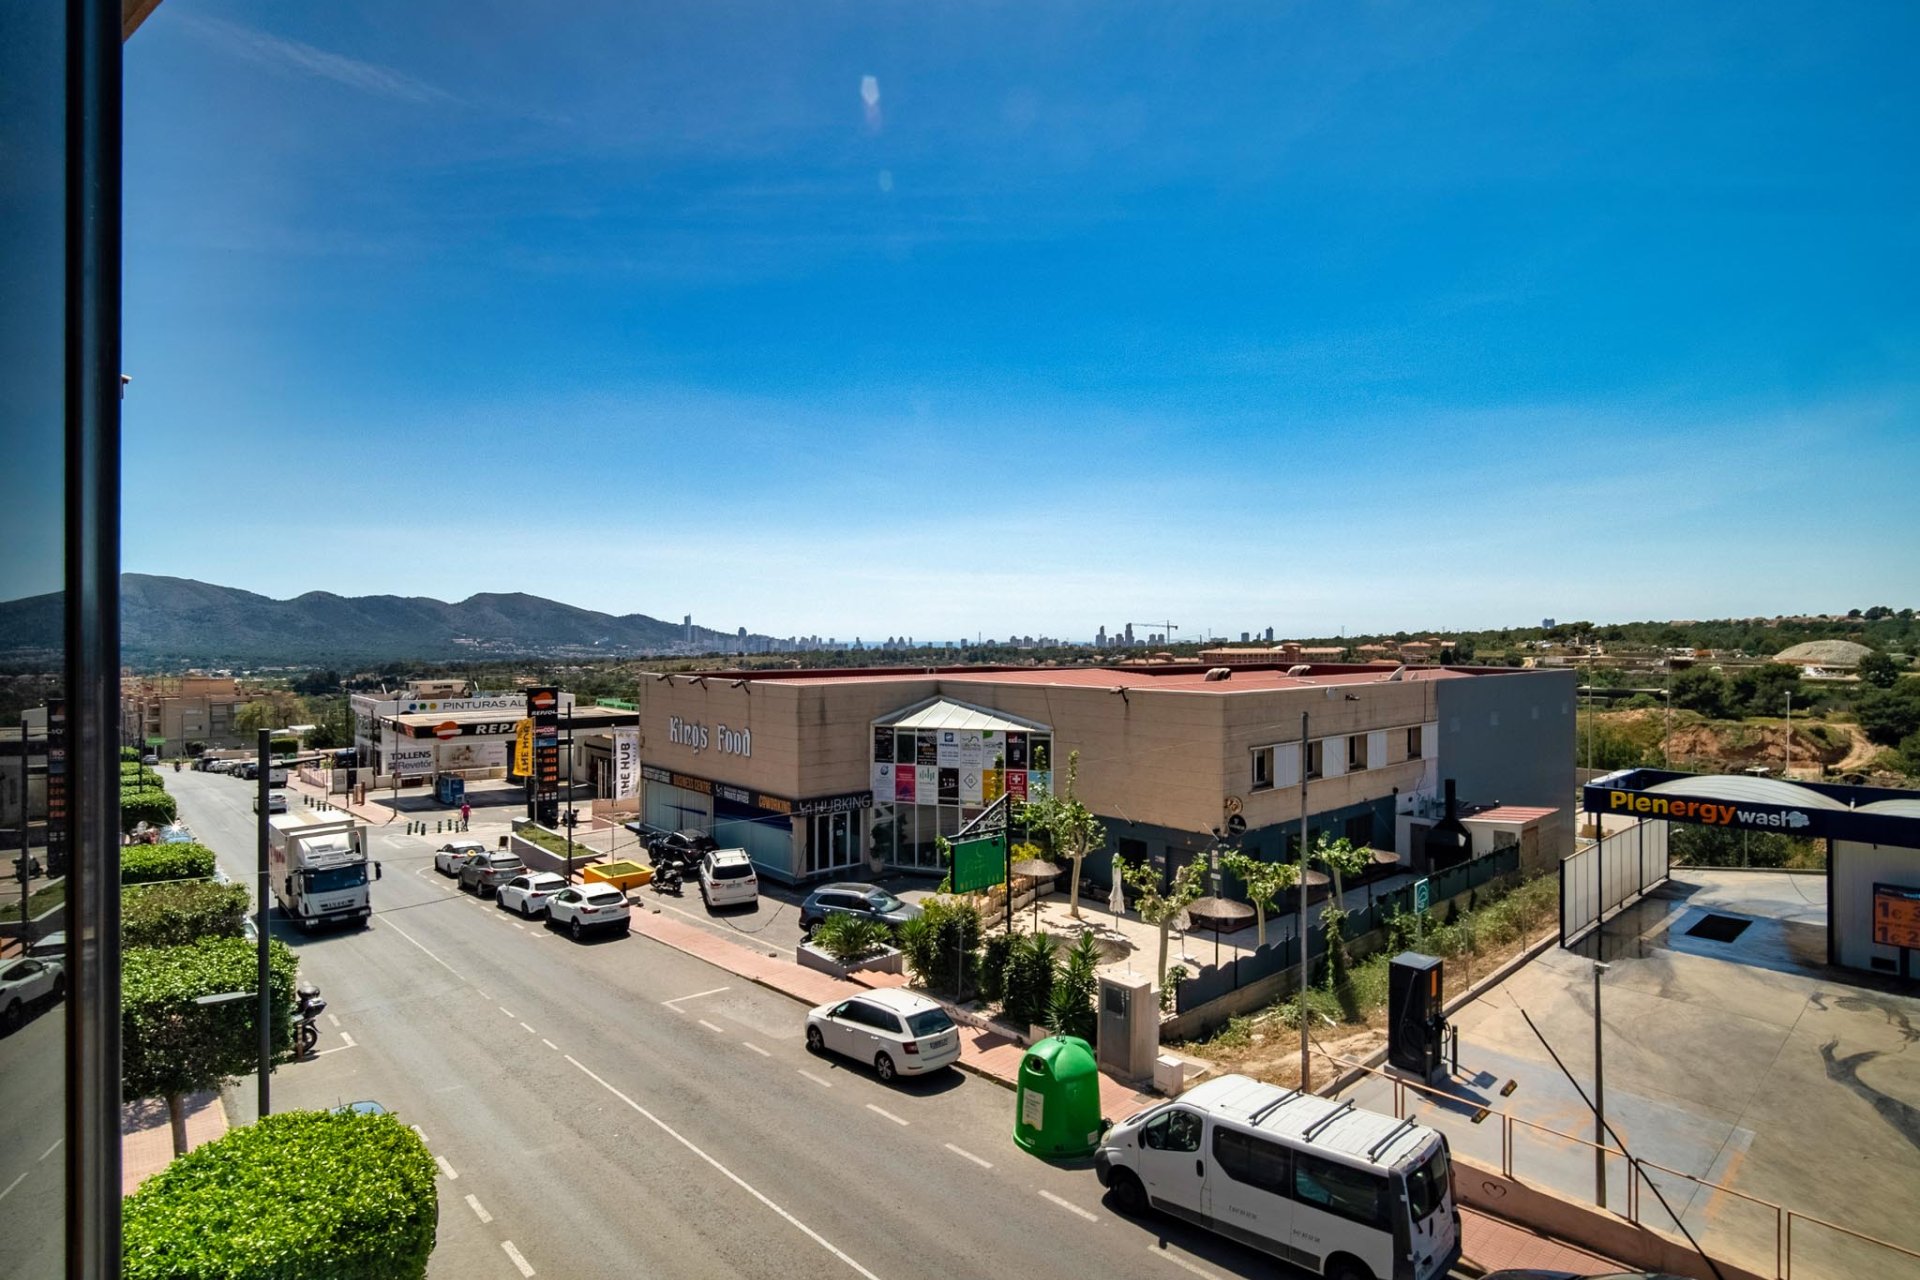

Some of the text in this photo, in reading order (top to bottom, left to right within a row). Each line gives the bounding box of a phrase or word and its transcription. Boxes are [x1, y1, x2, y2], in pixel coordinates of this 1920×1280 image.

[443, 699, 528, 710] PINTURAS AL
[717, 723, 752, 757] Food
[390, 750, 432, 761] TOLLENS
[620, 742, 631, 797] THE HUB
[815, 794, 871, 813] HUBKING
[1610, 791, 1737, 824] Plenergy
